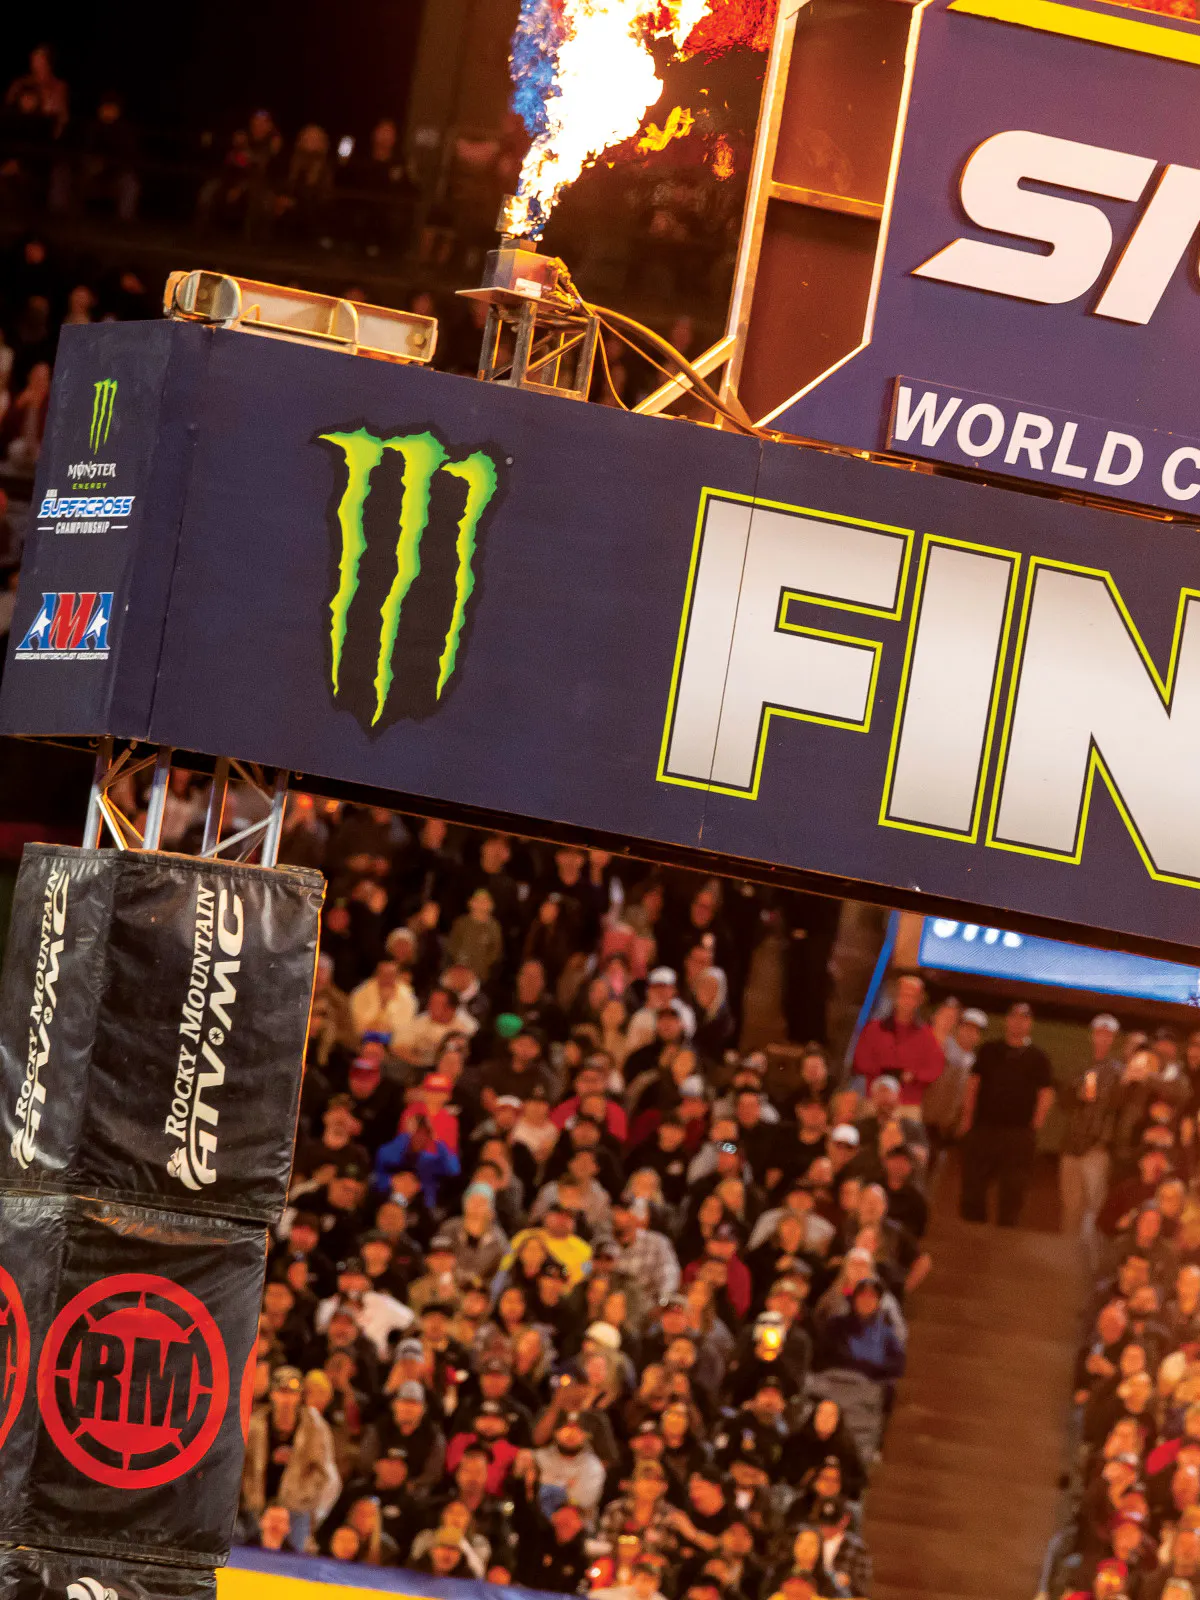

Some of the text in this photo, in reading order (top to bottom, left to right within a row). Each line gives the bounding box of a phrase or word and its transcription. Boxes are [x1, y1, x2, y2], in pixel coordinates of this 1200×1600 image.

[67, 461, 117, 480] MONSTER
[894, 386, 1144, 486] WORLD
[37, 496, 136, 518] SUPERCROSS
[56, 521, 110, 534] CHAMPIONSHIP
[15, 592, 114, 650] AMA
[15, 870, 60, 1122] ROCKY MOUNTAIN
[164, 884, 216, 1142] ROCKY MOUNTAIN
[74, 1330, 196, 1430] RM
